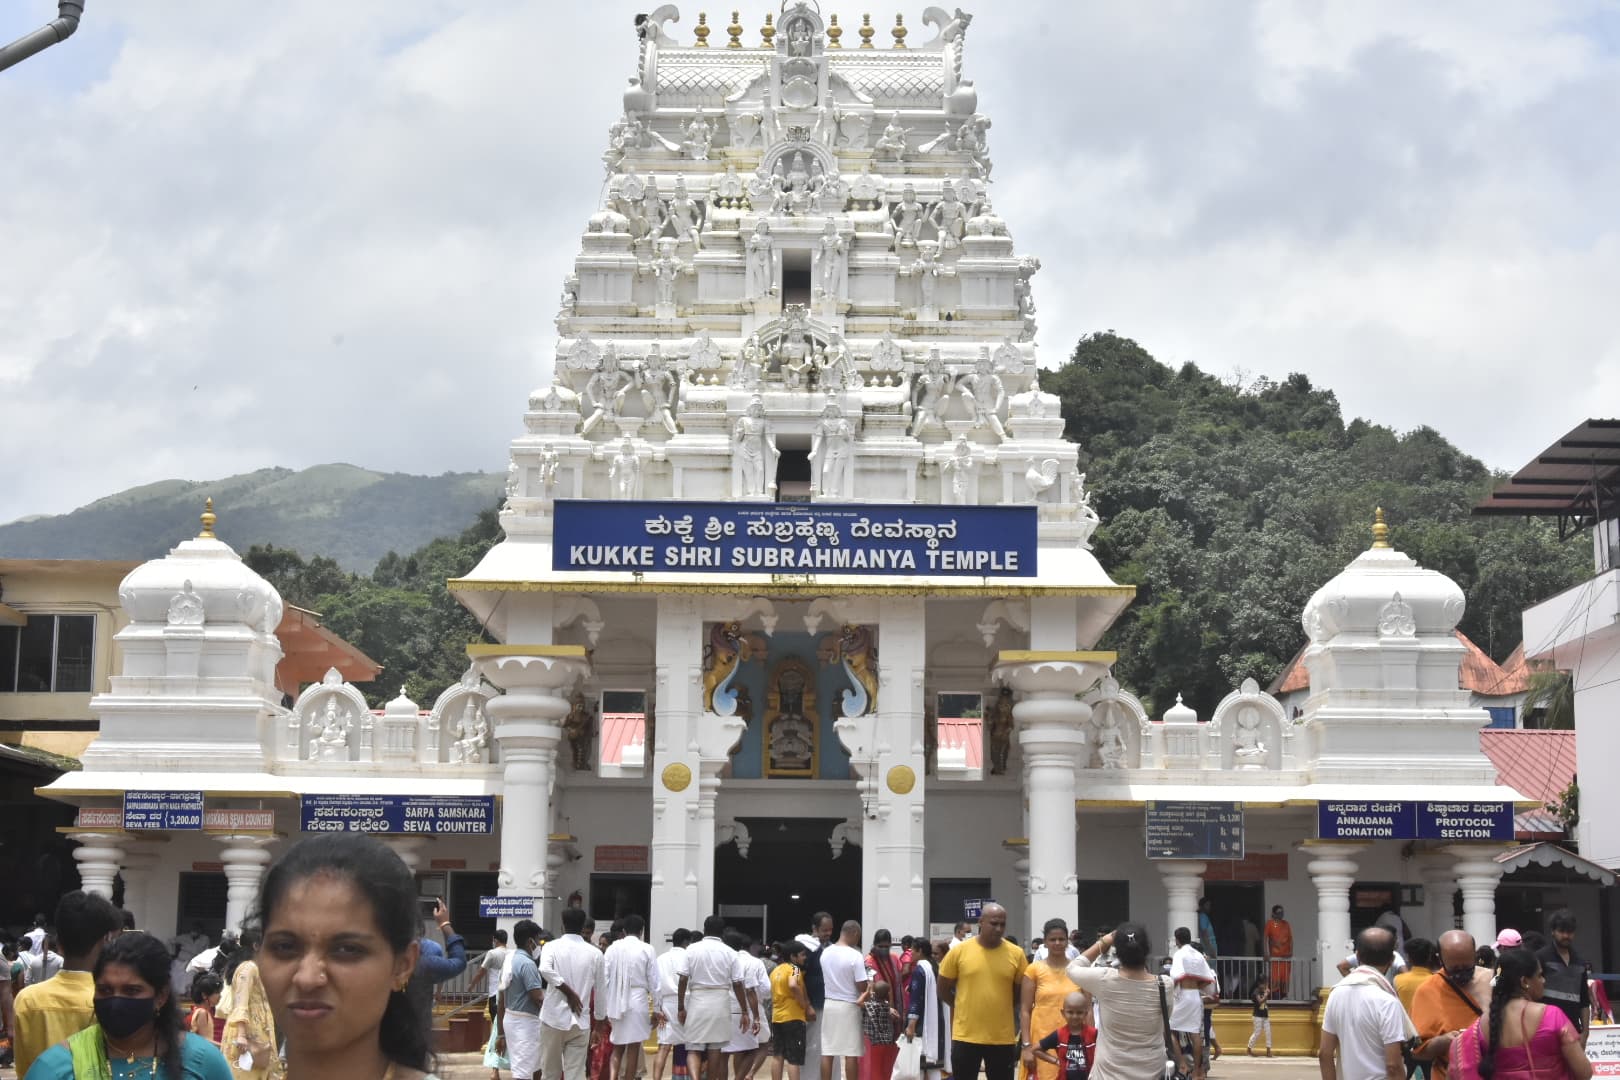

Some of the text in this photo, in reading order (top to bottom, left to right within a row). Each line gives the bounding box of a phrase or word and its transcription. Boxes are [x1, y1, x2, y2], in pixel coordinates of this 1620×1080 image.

[645, 515, 957, 549] ಕುಕ್ಕೆ ಶ್ರೀ ಸುಬ್ರಹ್ಮಣ್ಯ ದೇವಸ್ಥಾನ
[570, 545, 1018, 571] KUKKE SHRI SUBRAHMANYA TEMPLE
[405, 807, 486, 819] SARPA SAMSKARA
[170, 815, 200, 827] 3,200.00
[403, 820, 487, 833] SEVA COUNTER
[1336, 816, 1394, 825] ANNADANA
[1435, 818, 1496, 827] PROTOCOL
[1337, 827, 1393, 836] DONATION
[1440, 829, 1491, 838] SECTION
